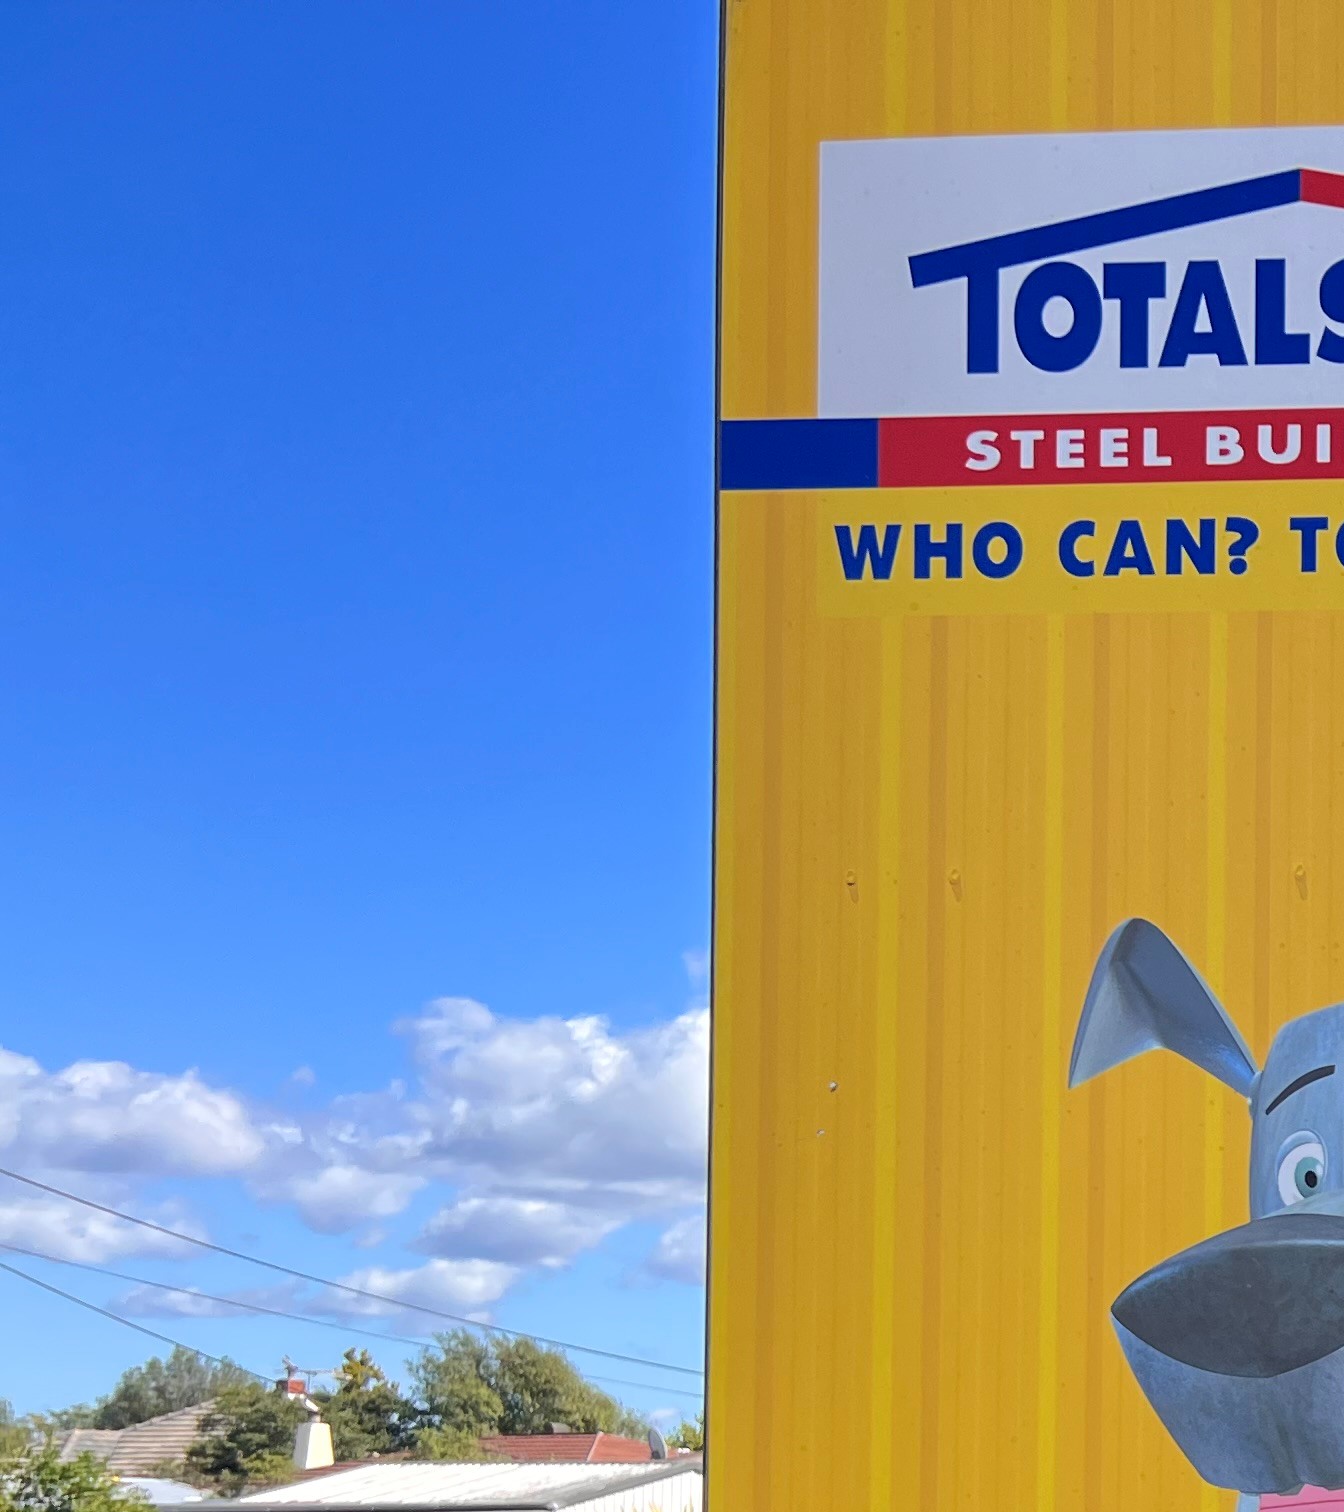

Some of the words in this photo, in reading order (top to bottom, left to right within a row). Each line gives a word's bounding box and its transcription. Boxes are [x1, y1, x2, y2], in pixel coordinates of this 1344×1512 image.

[963, 426, 1174, 473] STEEL
[833, 520, 1024, 581] WHO
[1057, 515, 1260, 578] CAN?
